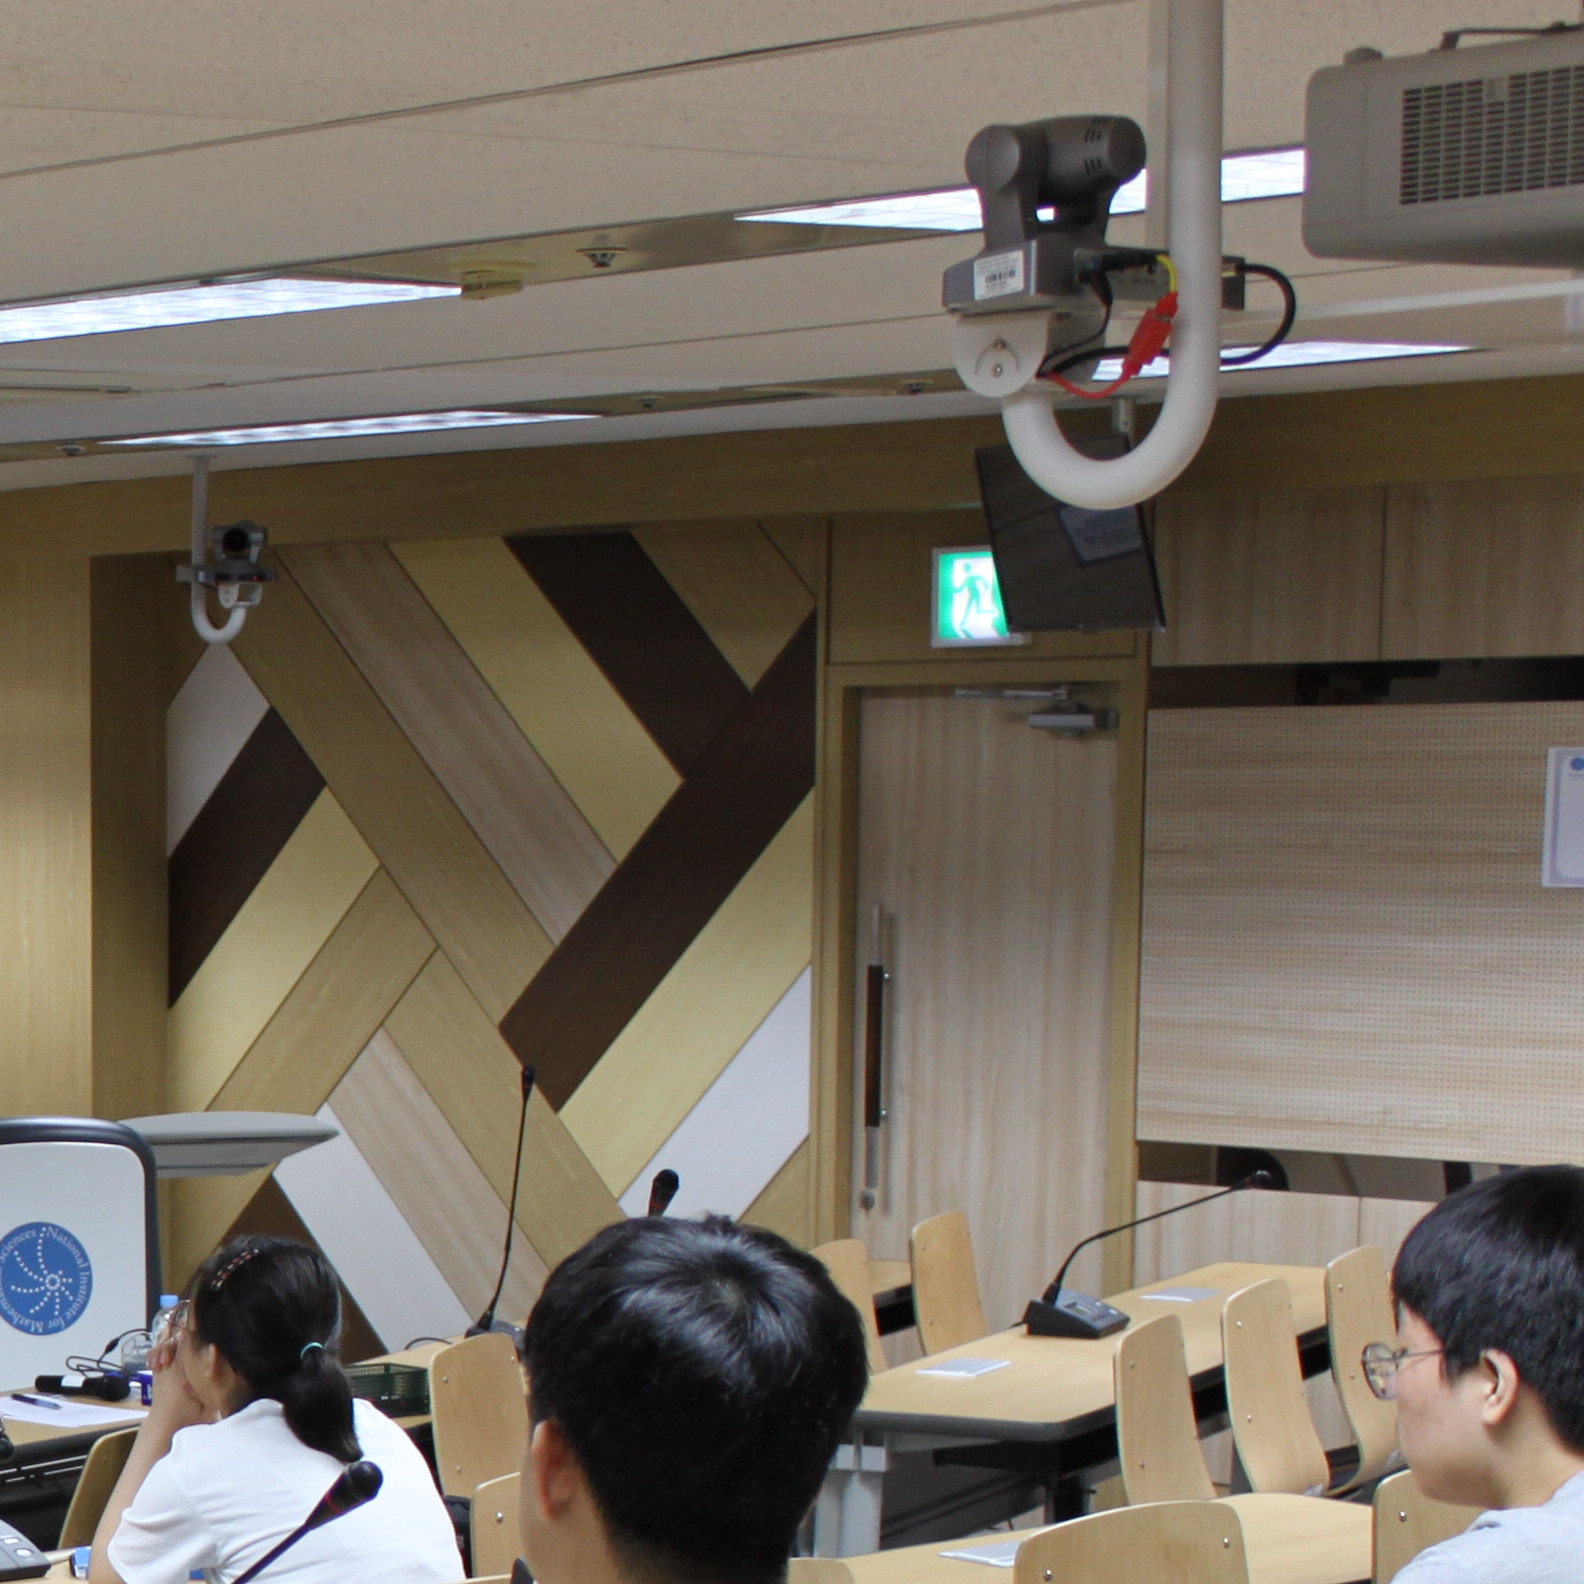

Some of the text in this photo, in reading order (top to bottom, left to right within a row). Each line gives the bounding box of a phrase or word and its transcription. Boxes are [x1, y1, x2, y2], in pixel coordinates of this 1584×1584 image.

[47, 1226, 89, 1268] National
[65, 1271, 90, 1319] Institute
[48, 1316, 65, 1330] for
